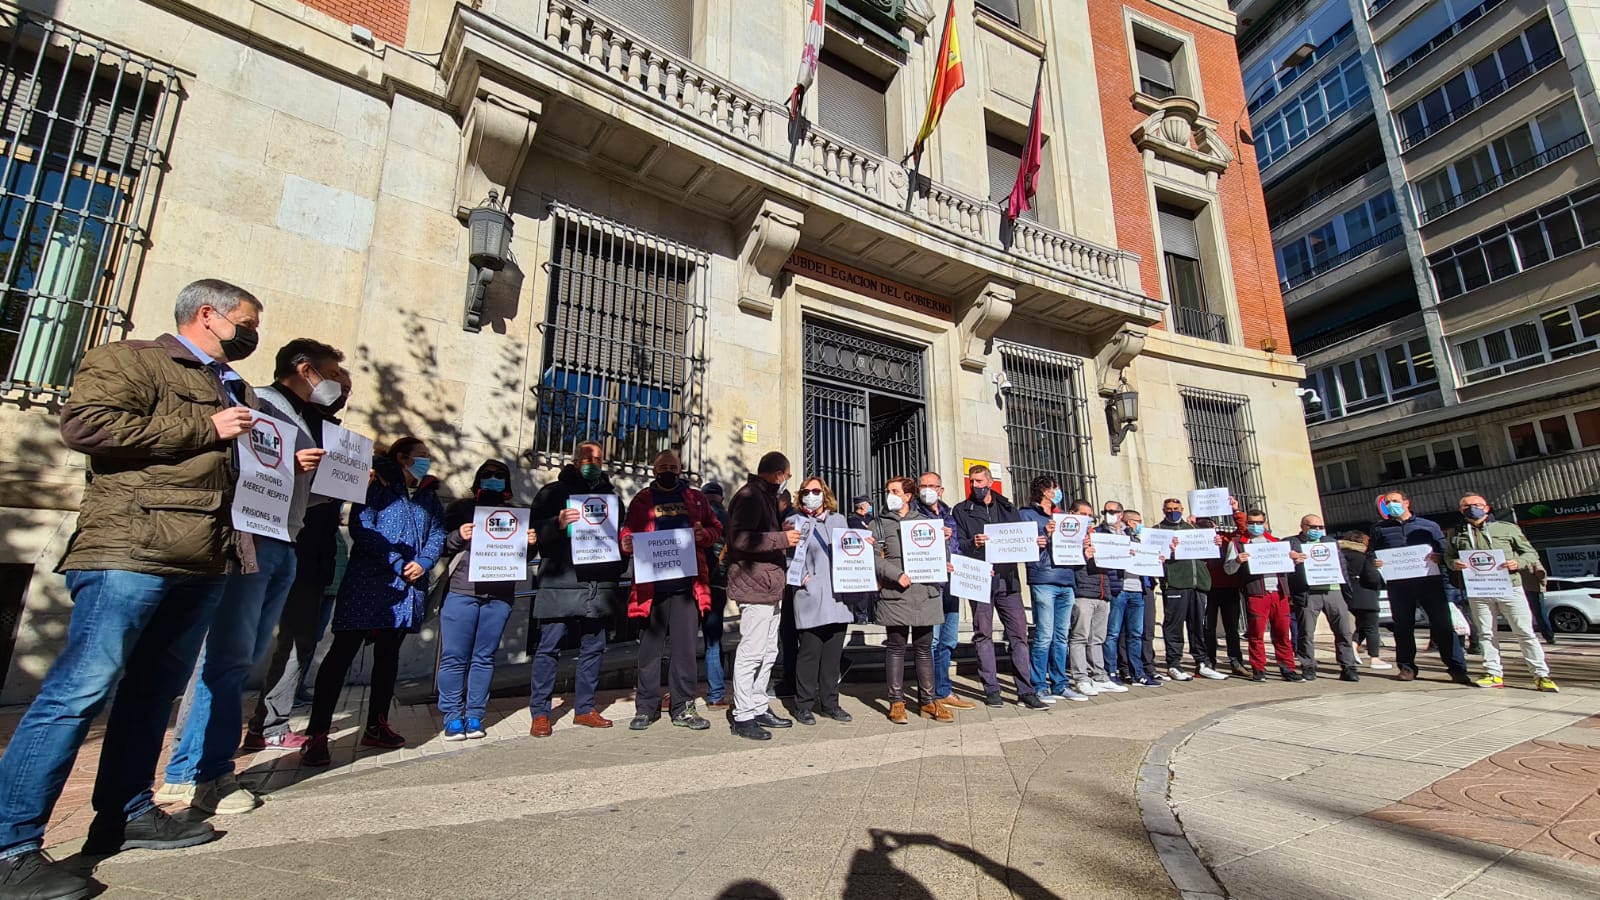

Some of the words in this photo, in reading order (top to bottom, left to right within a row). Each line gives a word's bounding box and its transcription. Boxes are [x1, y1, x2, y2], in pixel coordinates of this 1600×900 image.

[786, 254, 878, 291] SUBDELEGACION
[880, 283, 901, 299] DEL
[903, 291, 952, 314] GOBIERNO
[339, 437, 349, 449] NO
[327, 450, 361, 470] AGRESIONES
[361, 462, 369, 472] EN
[255, 470, 283, 487] PRISIONES
[331, 468, 360, 485] PRISIONES
[242, 479, 266, 496] MERECE
[266, 488, 289, 503] RESPETO
[241, 505, 271, 521] PRISIONES
[272, 514, 281, 524] SIN
[1554, 503, 1597, 515] Unicaja
[648, 538, 682, 547] PRISIONES
[652, 549, 680, 558] MERECE
[1555, 551, 1586, 562] SOMOS
[652, 560, 682, 569] RESPETO
